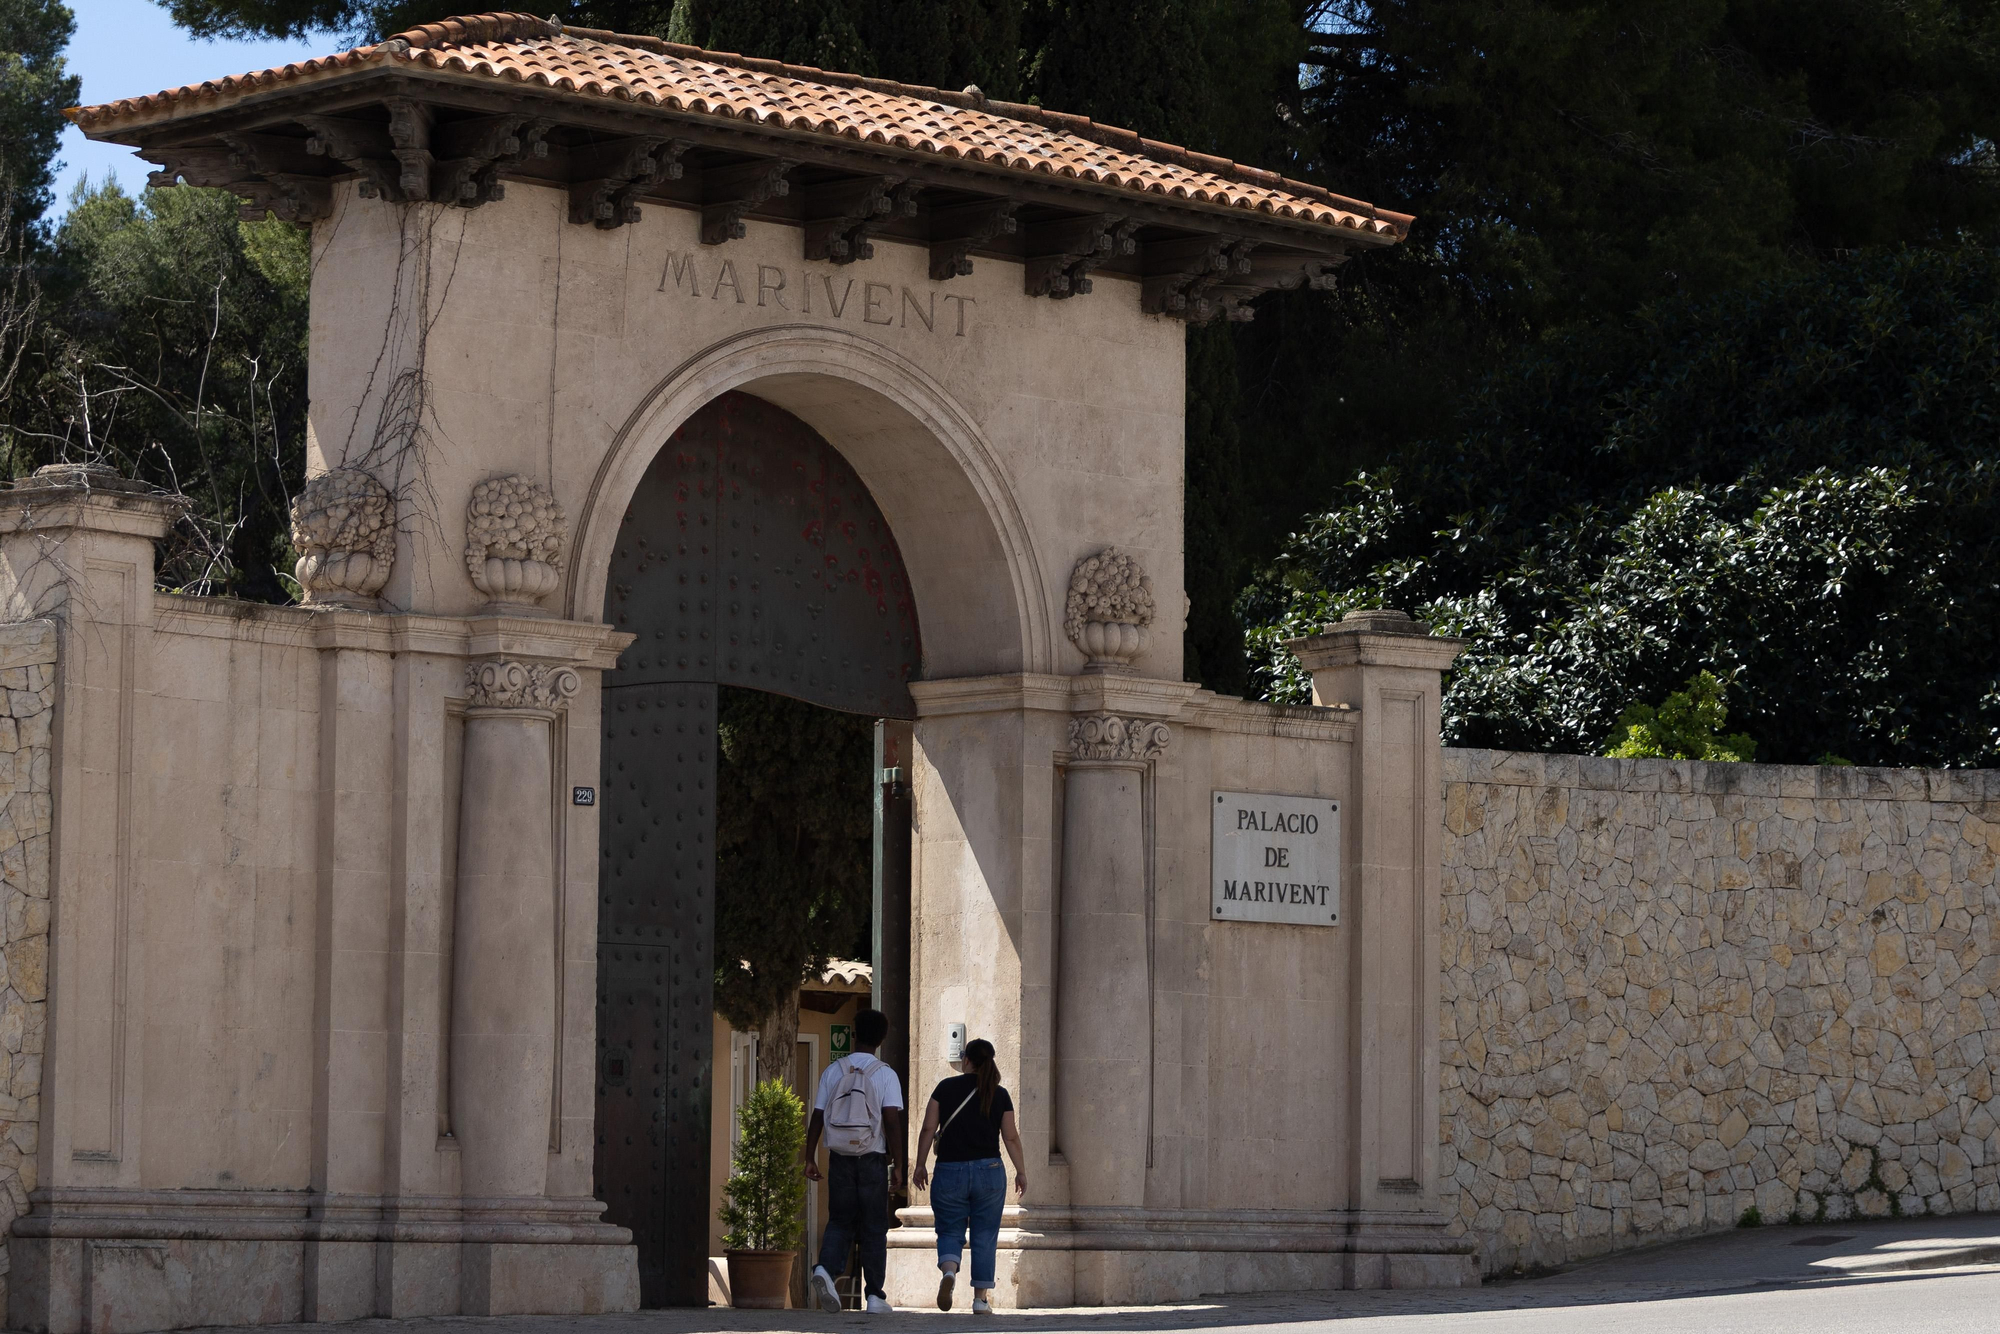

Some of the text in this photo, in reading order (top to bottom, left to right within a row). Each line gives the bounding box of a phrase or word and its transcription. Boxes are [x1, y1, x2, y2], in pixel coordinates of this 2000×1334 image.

[656, 249, 977, 337] MARIVENT
[576, 790, 593, 802] 229
[1237, 809, 1319, 834] PALACIO
[1264, 846, 1290, 868] DE
[1223, 879, 1330, 906] MARIVENT
